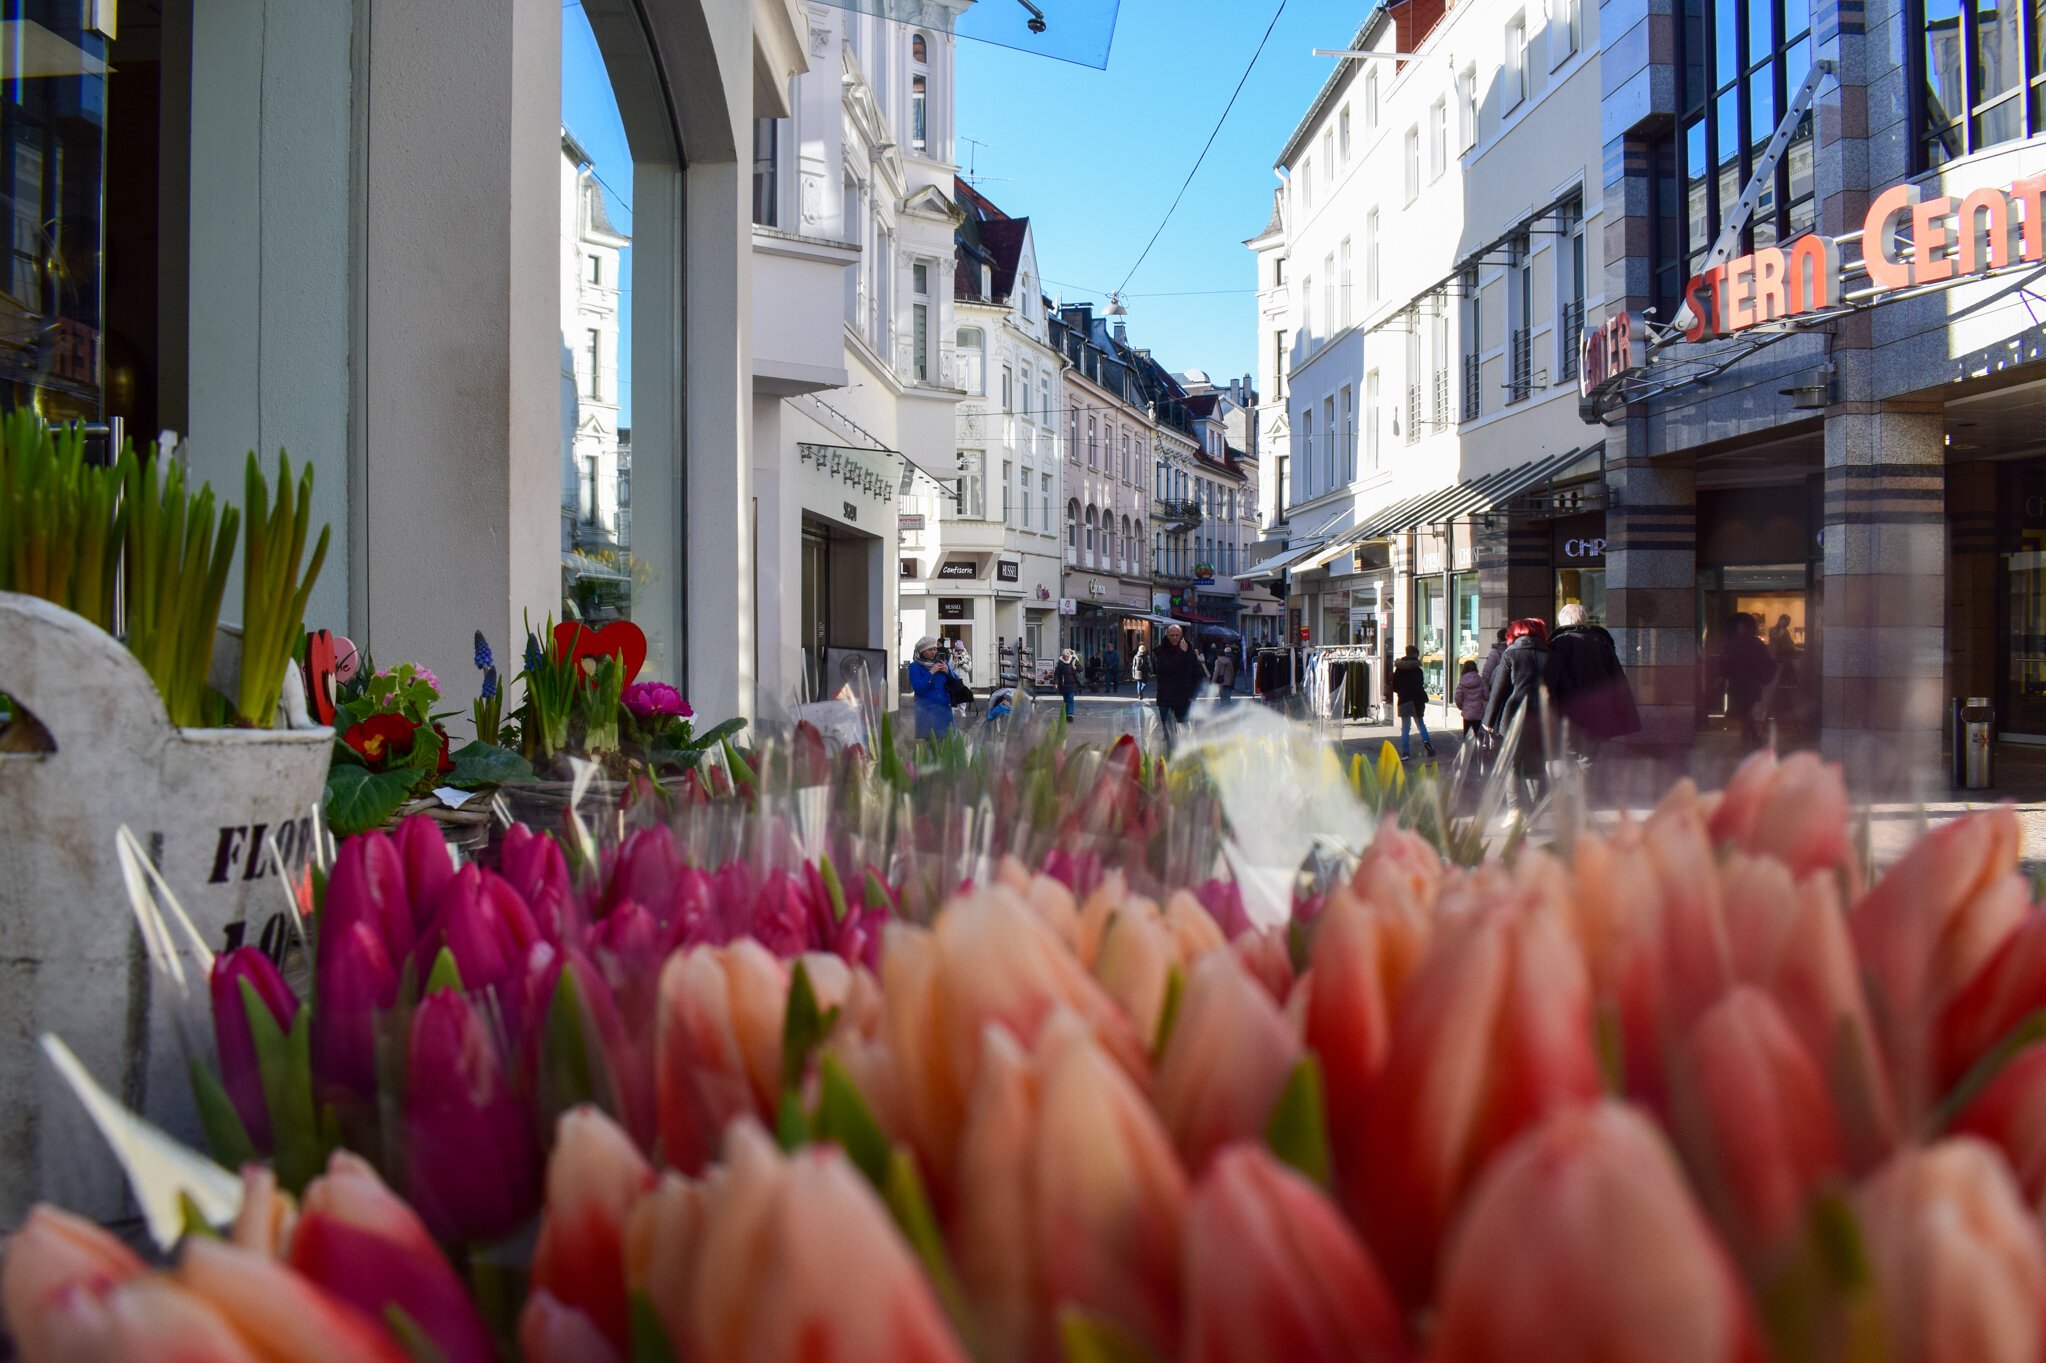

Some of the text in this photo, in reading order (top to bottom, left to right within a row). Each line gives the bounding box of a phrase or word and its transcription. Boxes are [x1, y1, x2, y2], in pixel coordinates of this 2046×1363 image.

[1686, 234, 1828, 344] STERN
[942, 565, 973, 575] Confiserie
[1002, 564, 1018, 579] HUSSEL
